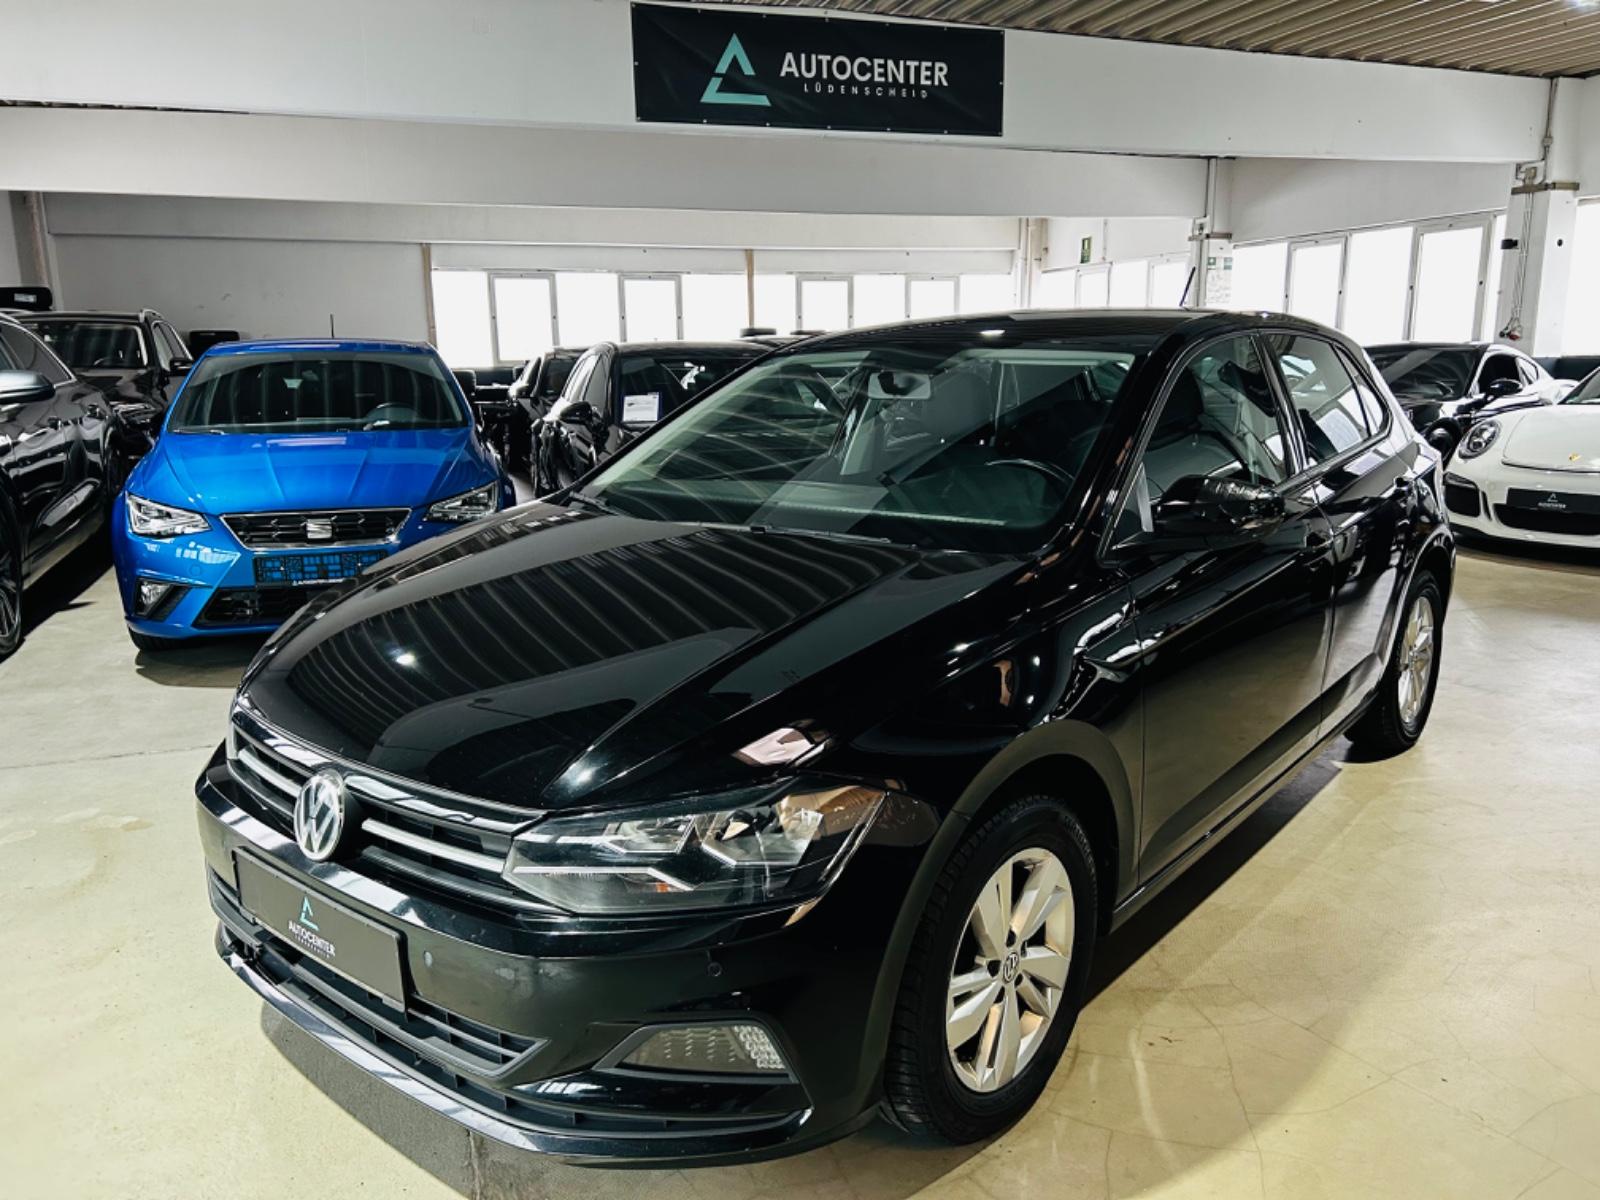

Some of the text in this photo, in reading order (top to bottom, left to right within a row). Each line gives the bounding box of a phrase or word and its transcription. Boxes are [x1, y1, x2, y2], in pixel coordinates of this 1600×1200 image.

[779, 51, 949, 87] AUTOCENTER
[803, 81, 929, 99] LÜDENSCHEID
[288, 920, 336, 956] AUTOCENTER
